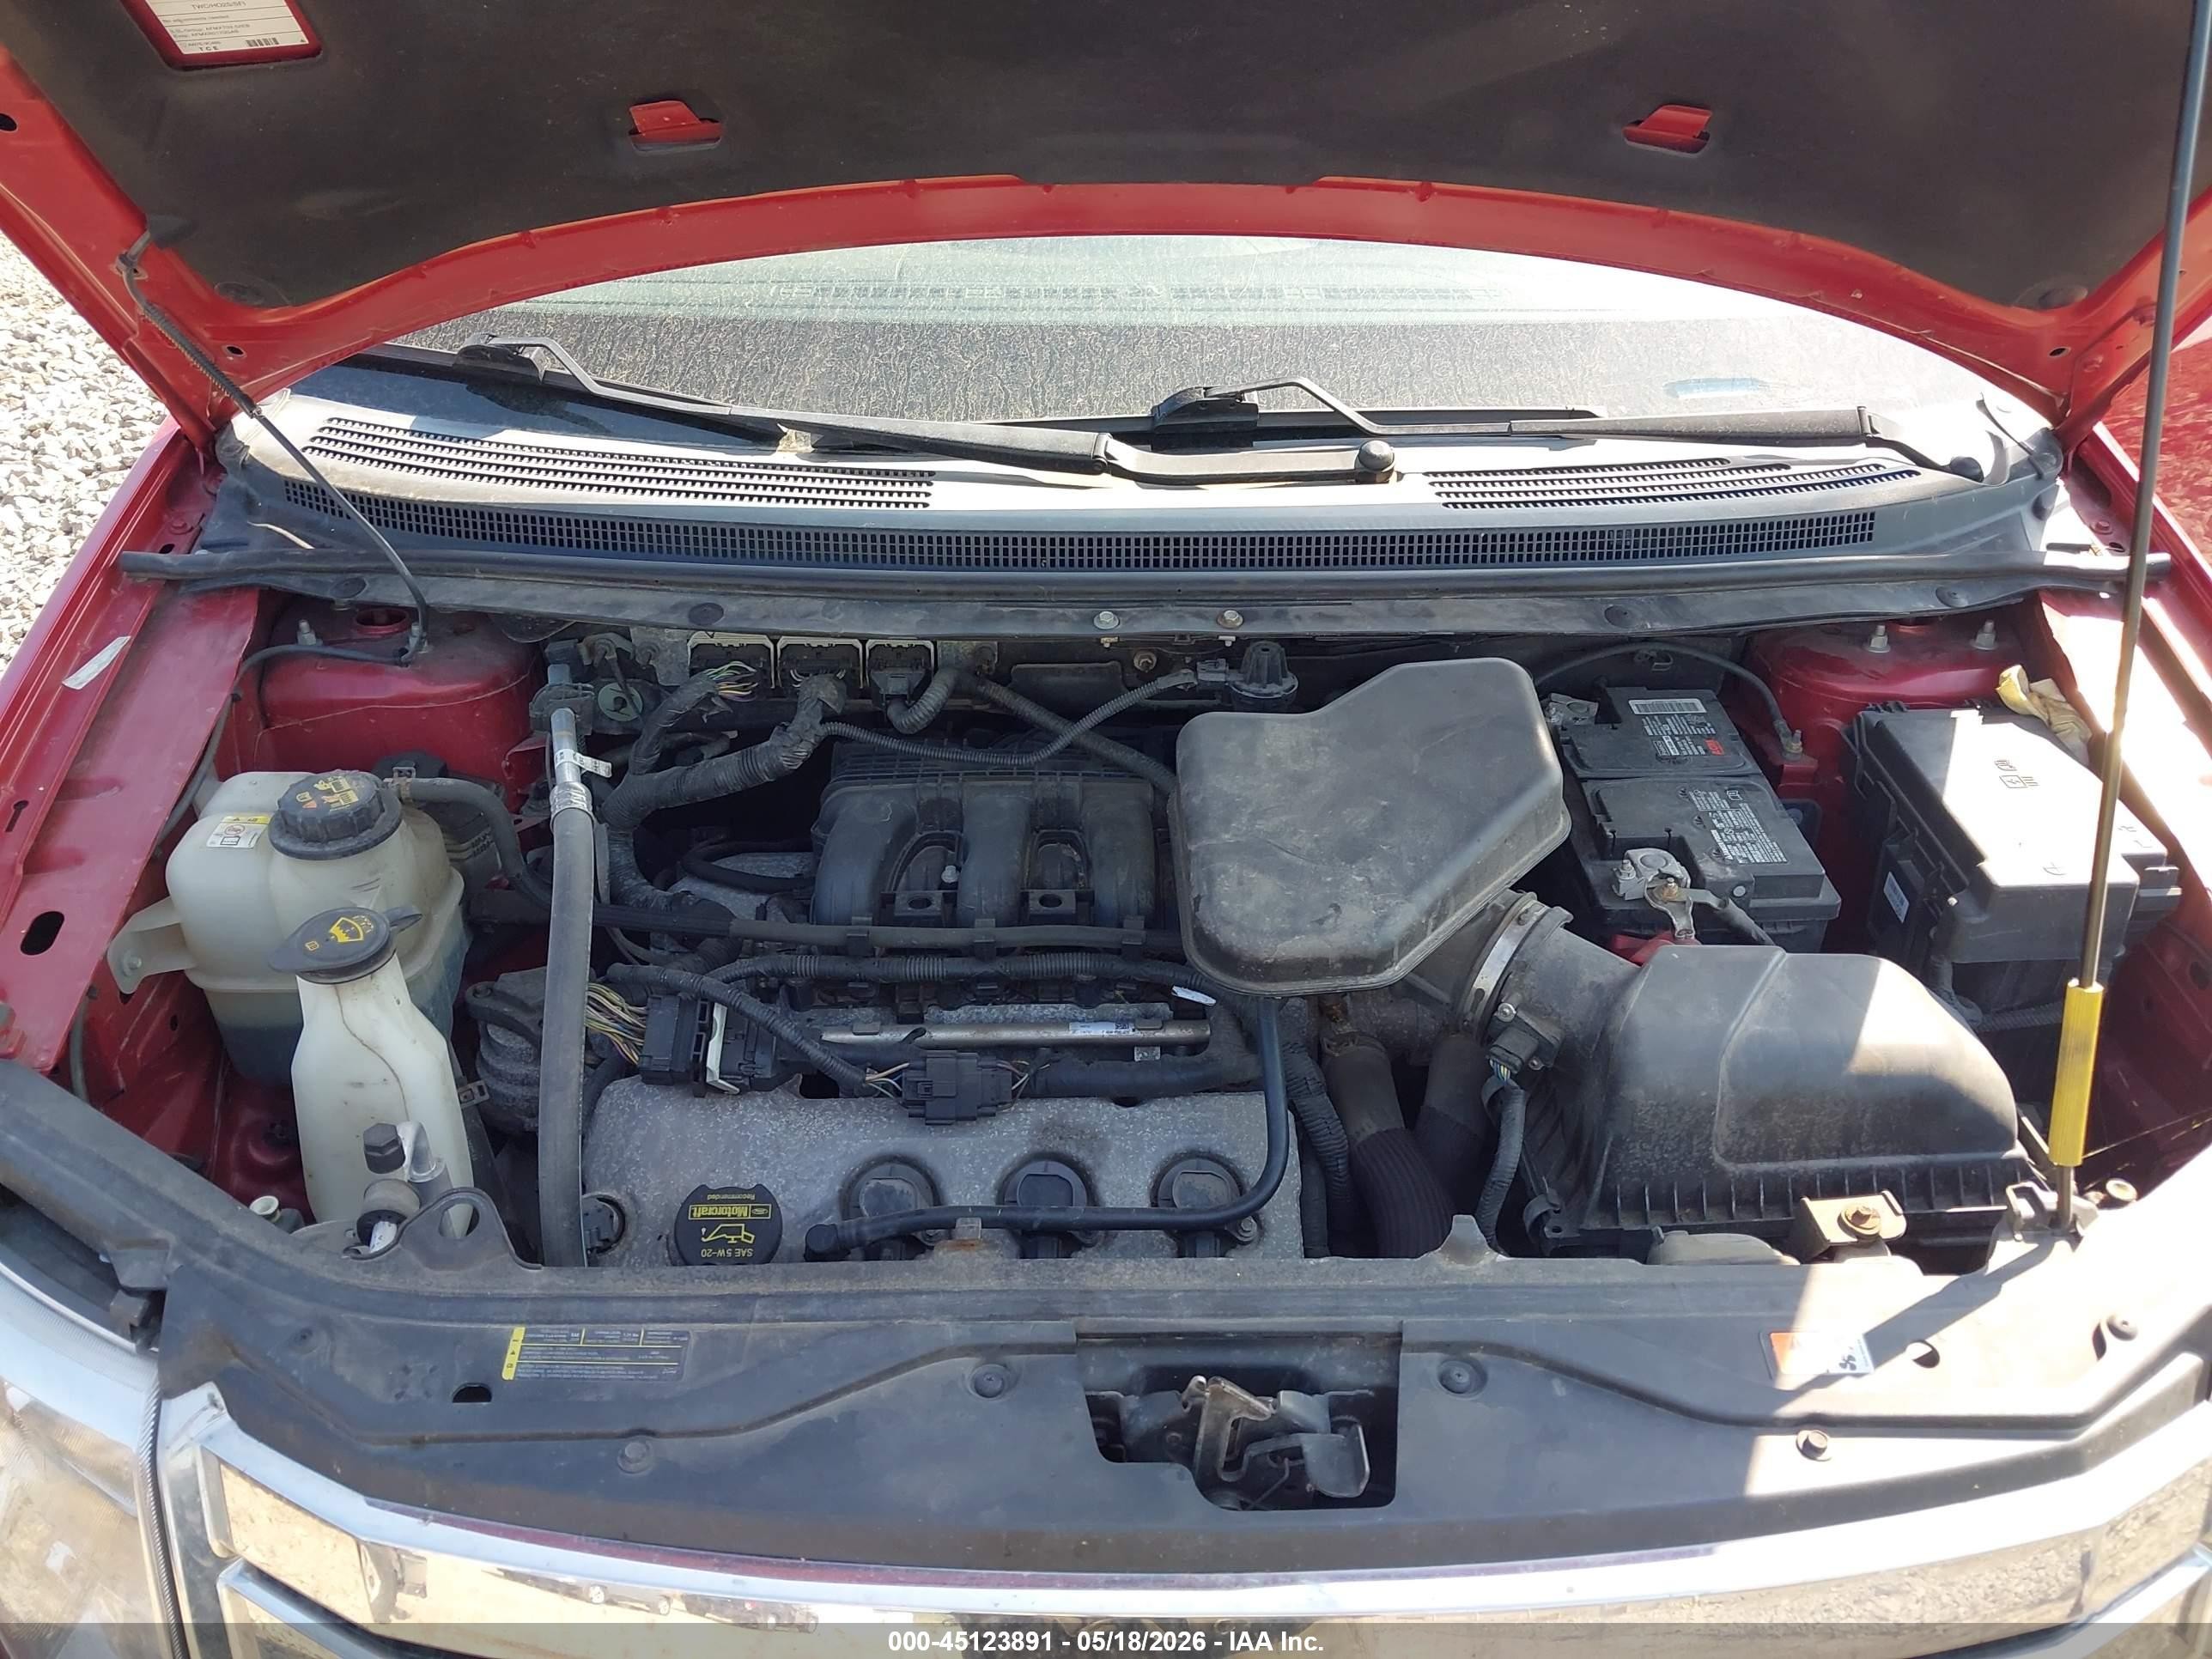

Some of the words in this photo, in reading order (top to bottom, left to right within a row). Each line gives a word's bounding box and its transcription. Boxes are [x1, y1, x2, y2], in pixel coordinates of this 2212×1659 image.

[692, 1206, 749, 1218] Motorcraft
[701, 1249, 732, 1258] 5W-20
[735, 1249, 754, 1257] SAE
